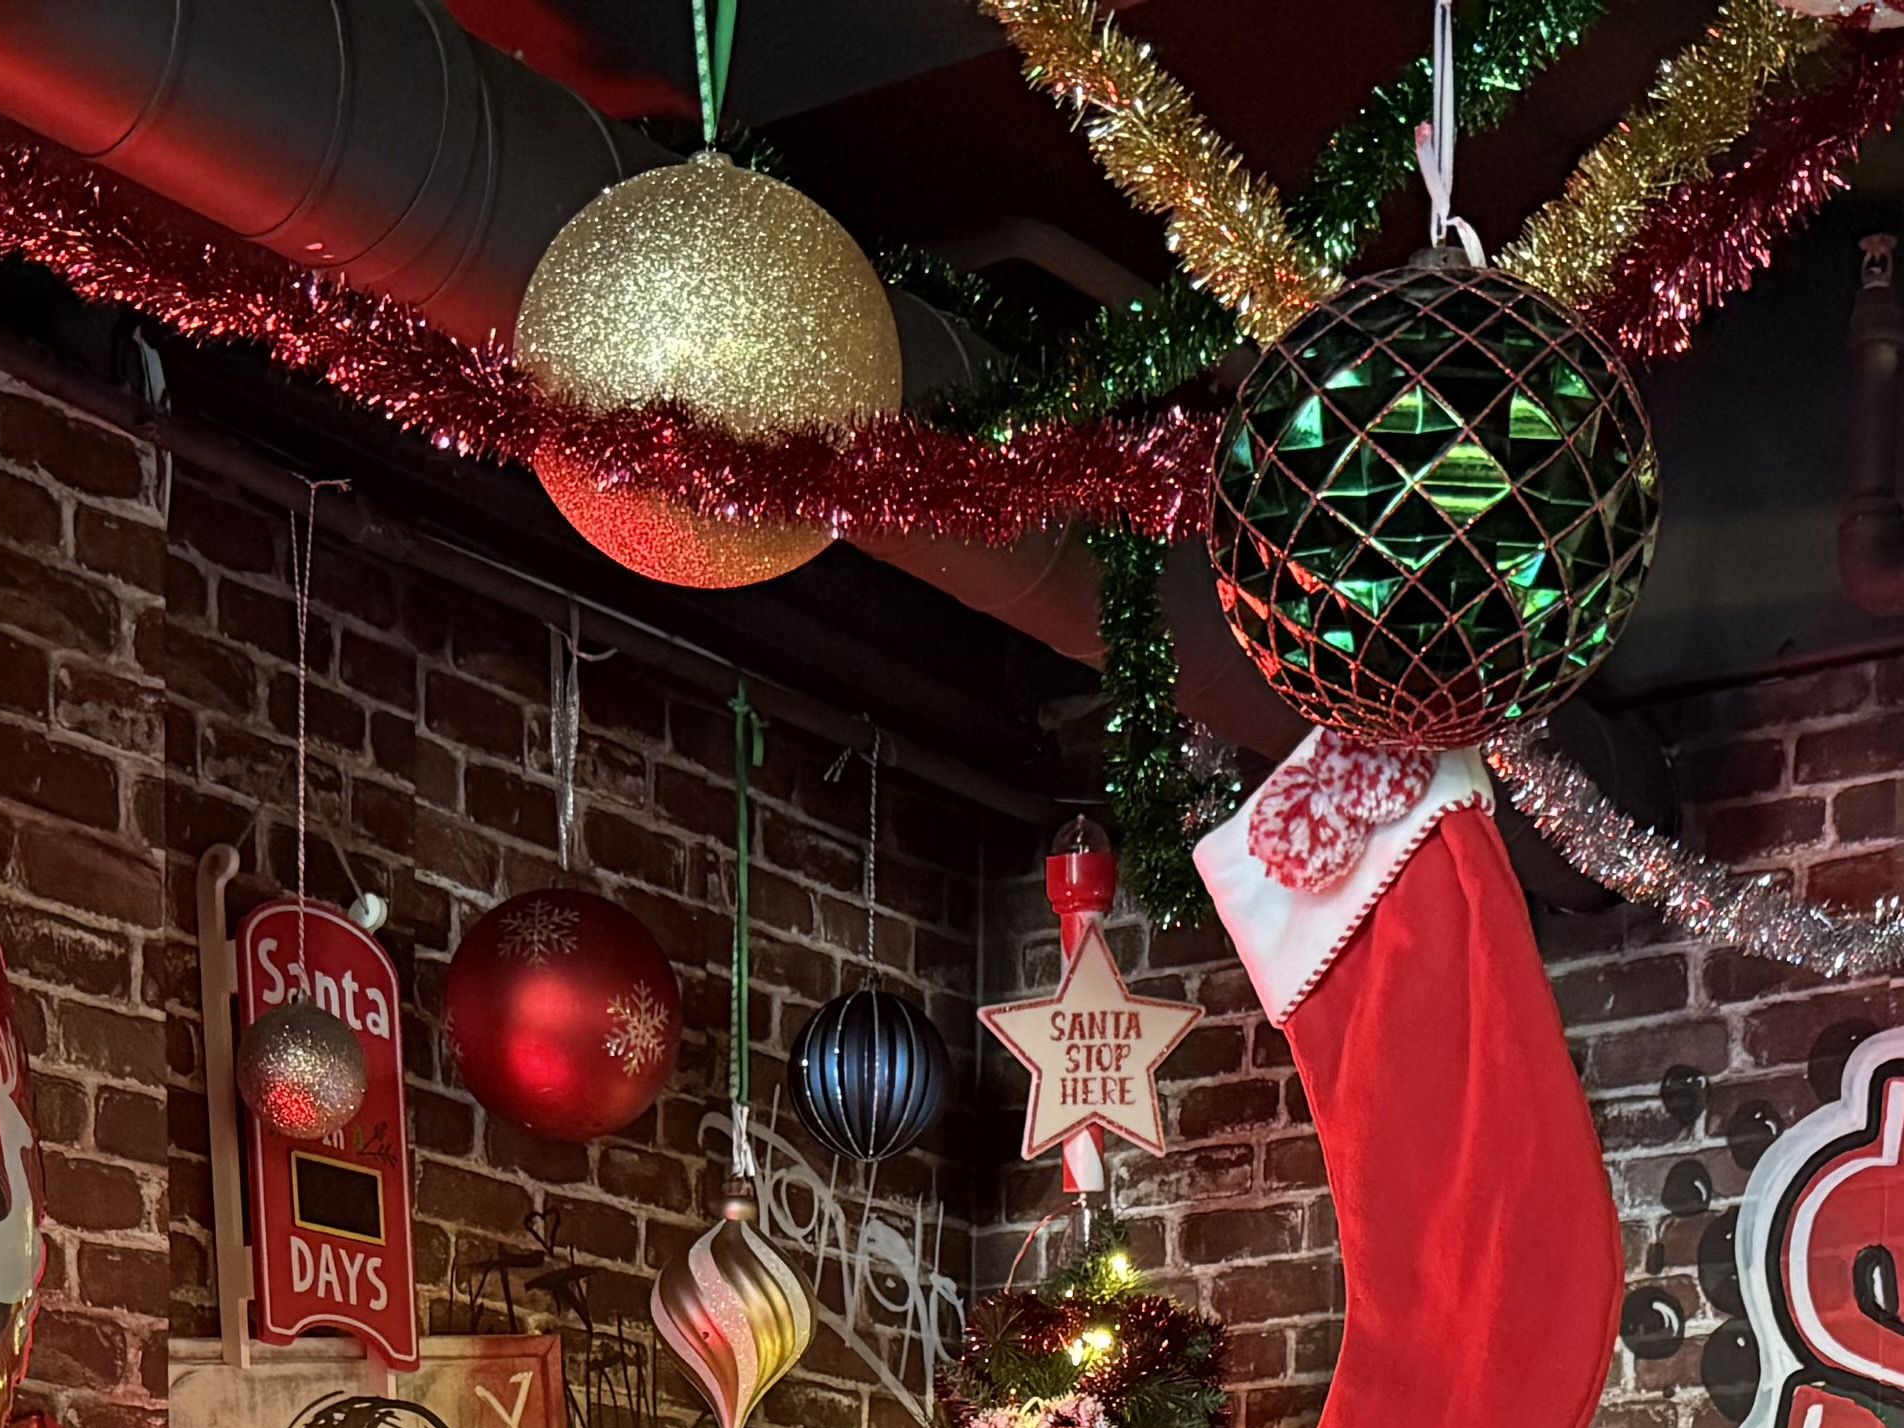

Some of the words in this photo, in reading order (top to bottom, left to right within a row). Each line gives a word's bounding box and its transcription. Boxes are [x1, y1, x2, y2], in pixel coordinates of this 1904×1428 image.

[258, 937, 391, 1041] Santa
[1050, 1011, 1142, 1041] SANTA
[1064, 1043, 1132, 1073] STOP
[1060, 1077, 1136, 1105] HERE
[289, 1236, 388, 1311] DAYS
